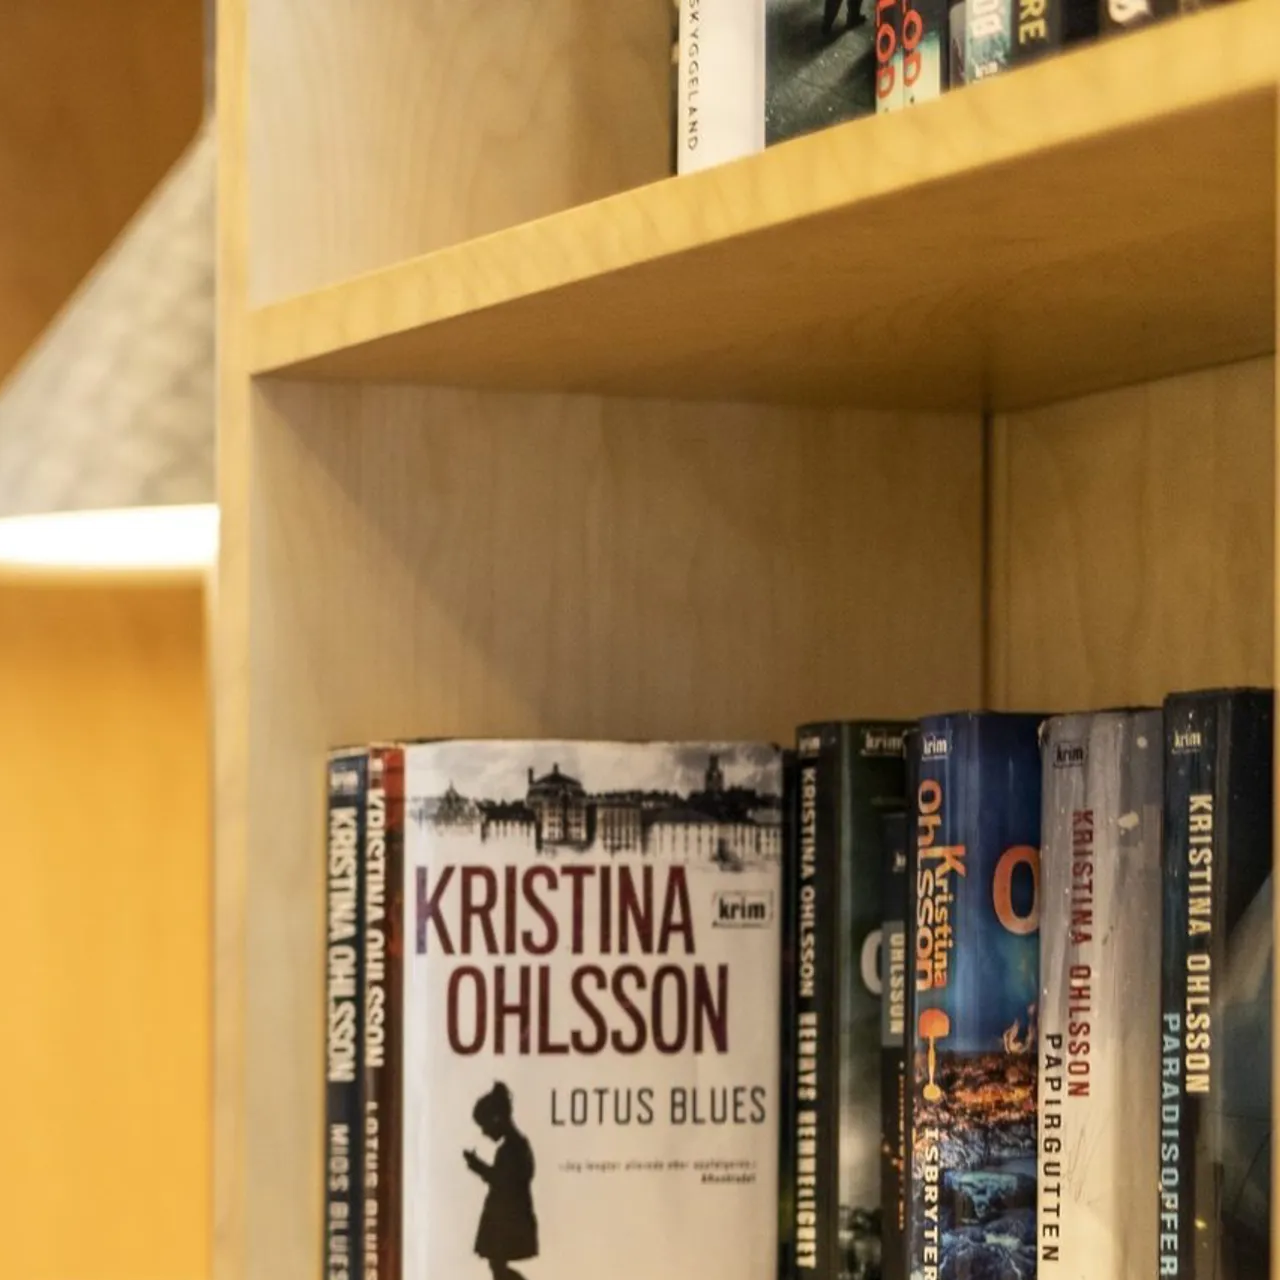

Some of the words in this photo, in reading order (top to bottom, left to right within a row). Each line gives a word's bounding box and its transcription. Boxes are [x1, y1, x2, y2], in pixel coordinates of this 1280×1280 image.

[1056, 746, 1084, 762] krim
[328, 806, 358, 943] KRISTINA
[365, 788, 386, 922] KRISTINA
[801, 768, 817, 880] KRISTINA
[1071, 809, 1094, 946] KRISTINA
[1188, 794, 1213, 937] KRISTINA
[415, 865, 696, 955] KRISTINA
[718, 898, 766, 920] krim
[799, 885, 816, 998] OHLSSON
[934, 845, 967, 988] Kristina
[327, 944, 357, 1081] OHLSSON
[446, 963, 729, 1056] OHLSSON
[1068, 964, 1092, 1097] OHLSSON
[1185, 953, 1211, 1094] OHLSSON
[550, 1088, 654, 1126] LOTUS
[669, 1086, 767, 1125] BLUES
[1042, 1033, 1063, 1263] PAPIRGUTTEN
